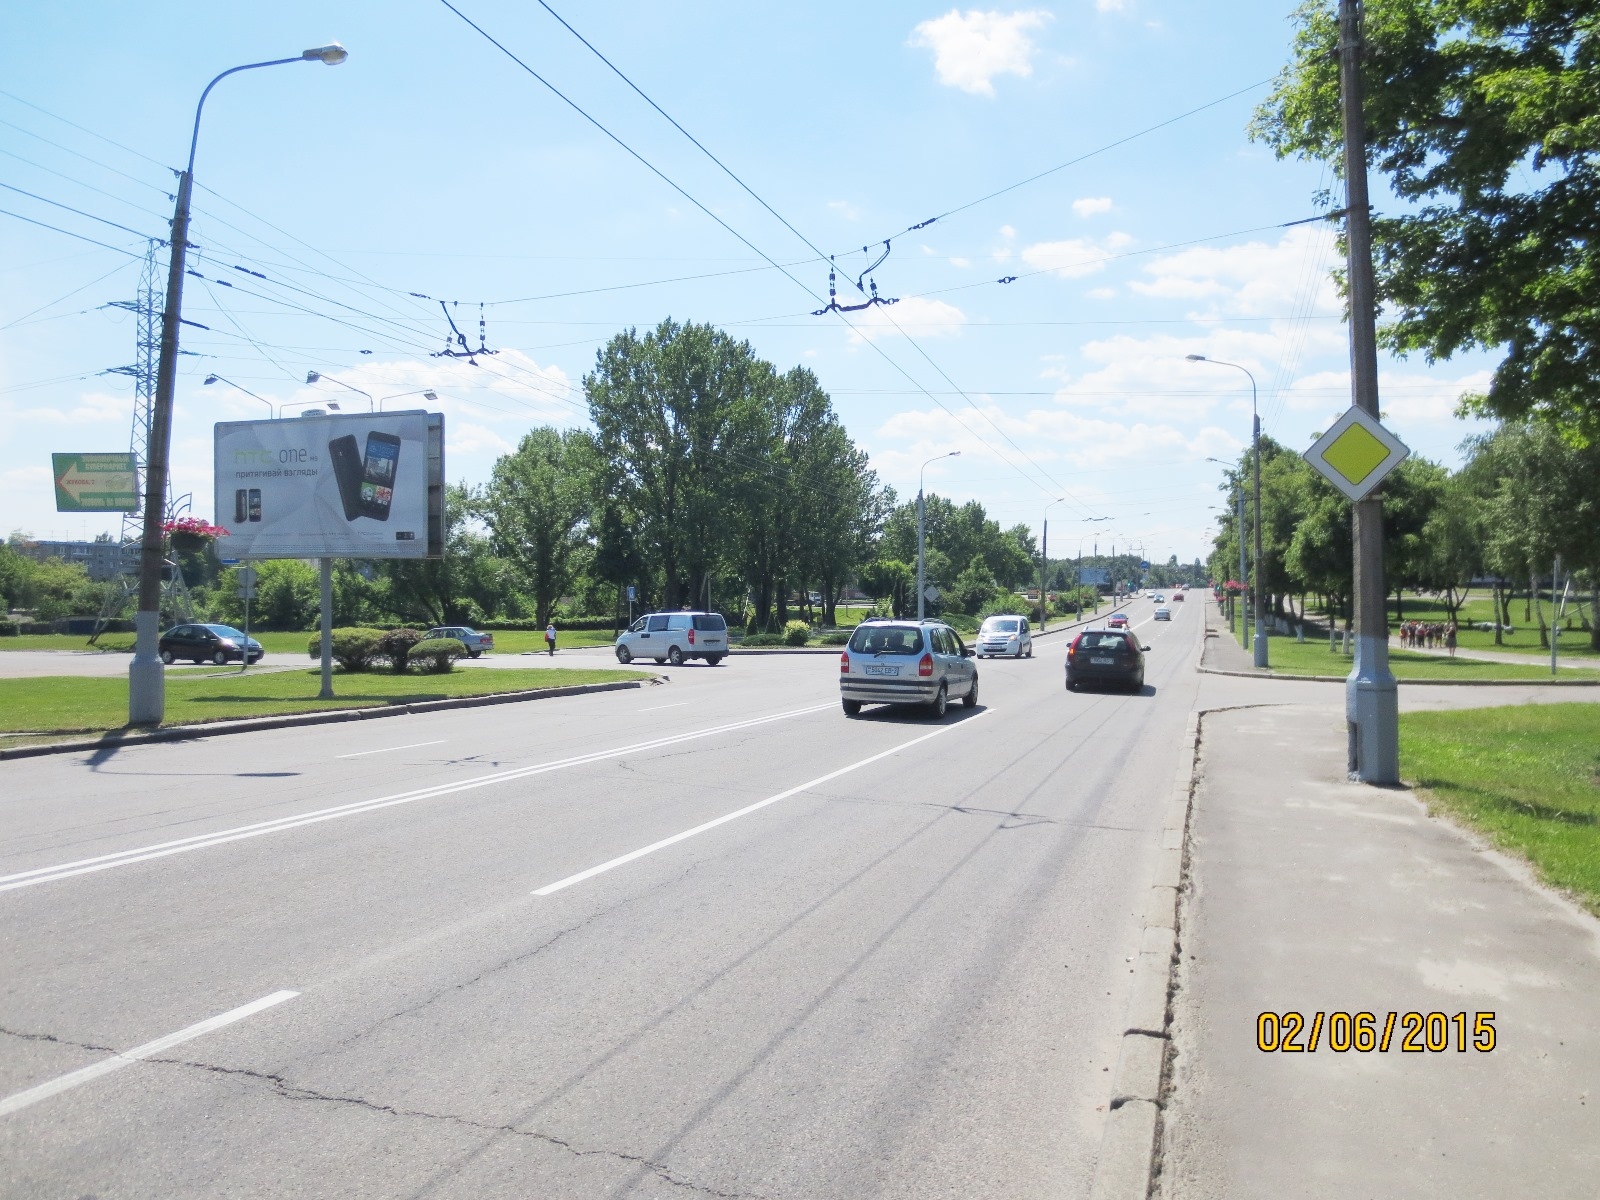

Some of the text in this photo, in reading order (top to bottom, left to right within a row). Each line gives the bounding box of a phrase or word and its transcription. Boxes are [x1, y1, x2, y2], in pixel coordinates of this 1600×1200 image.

[279, 448, 307, 464] one
[235, 468, 318, 479] притягивай взгляды
